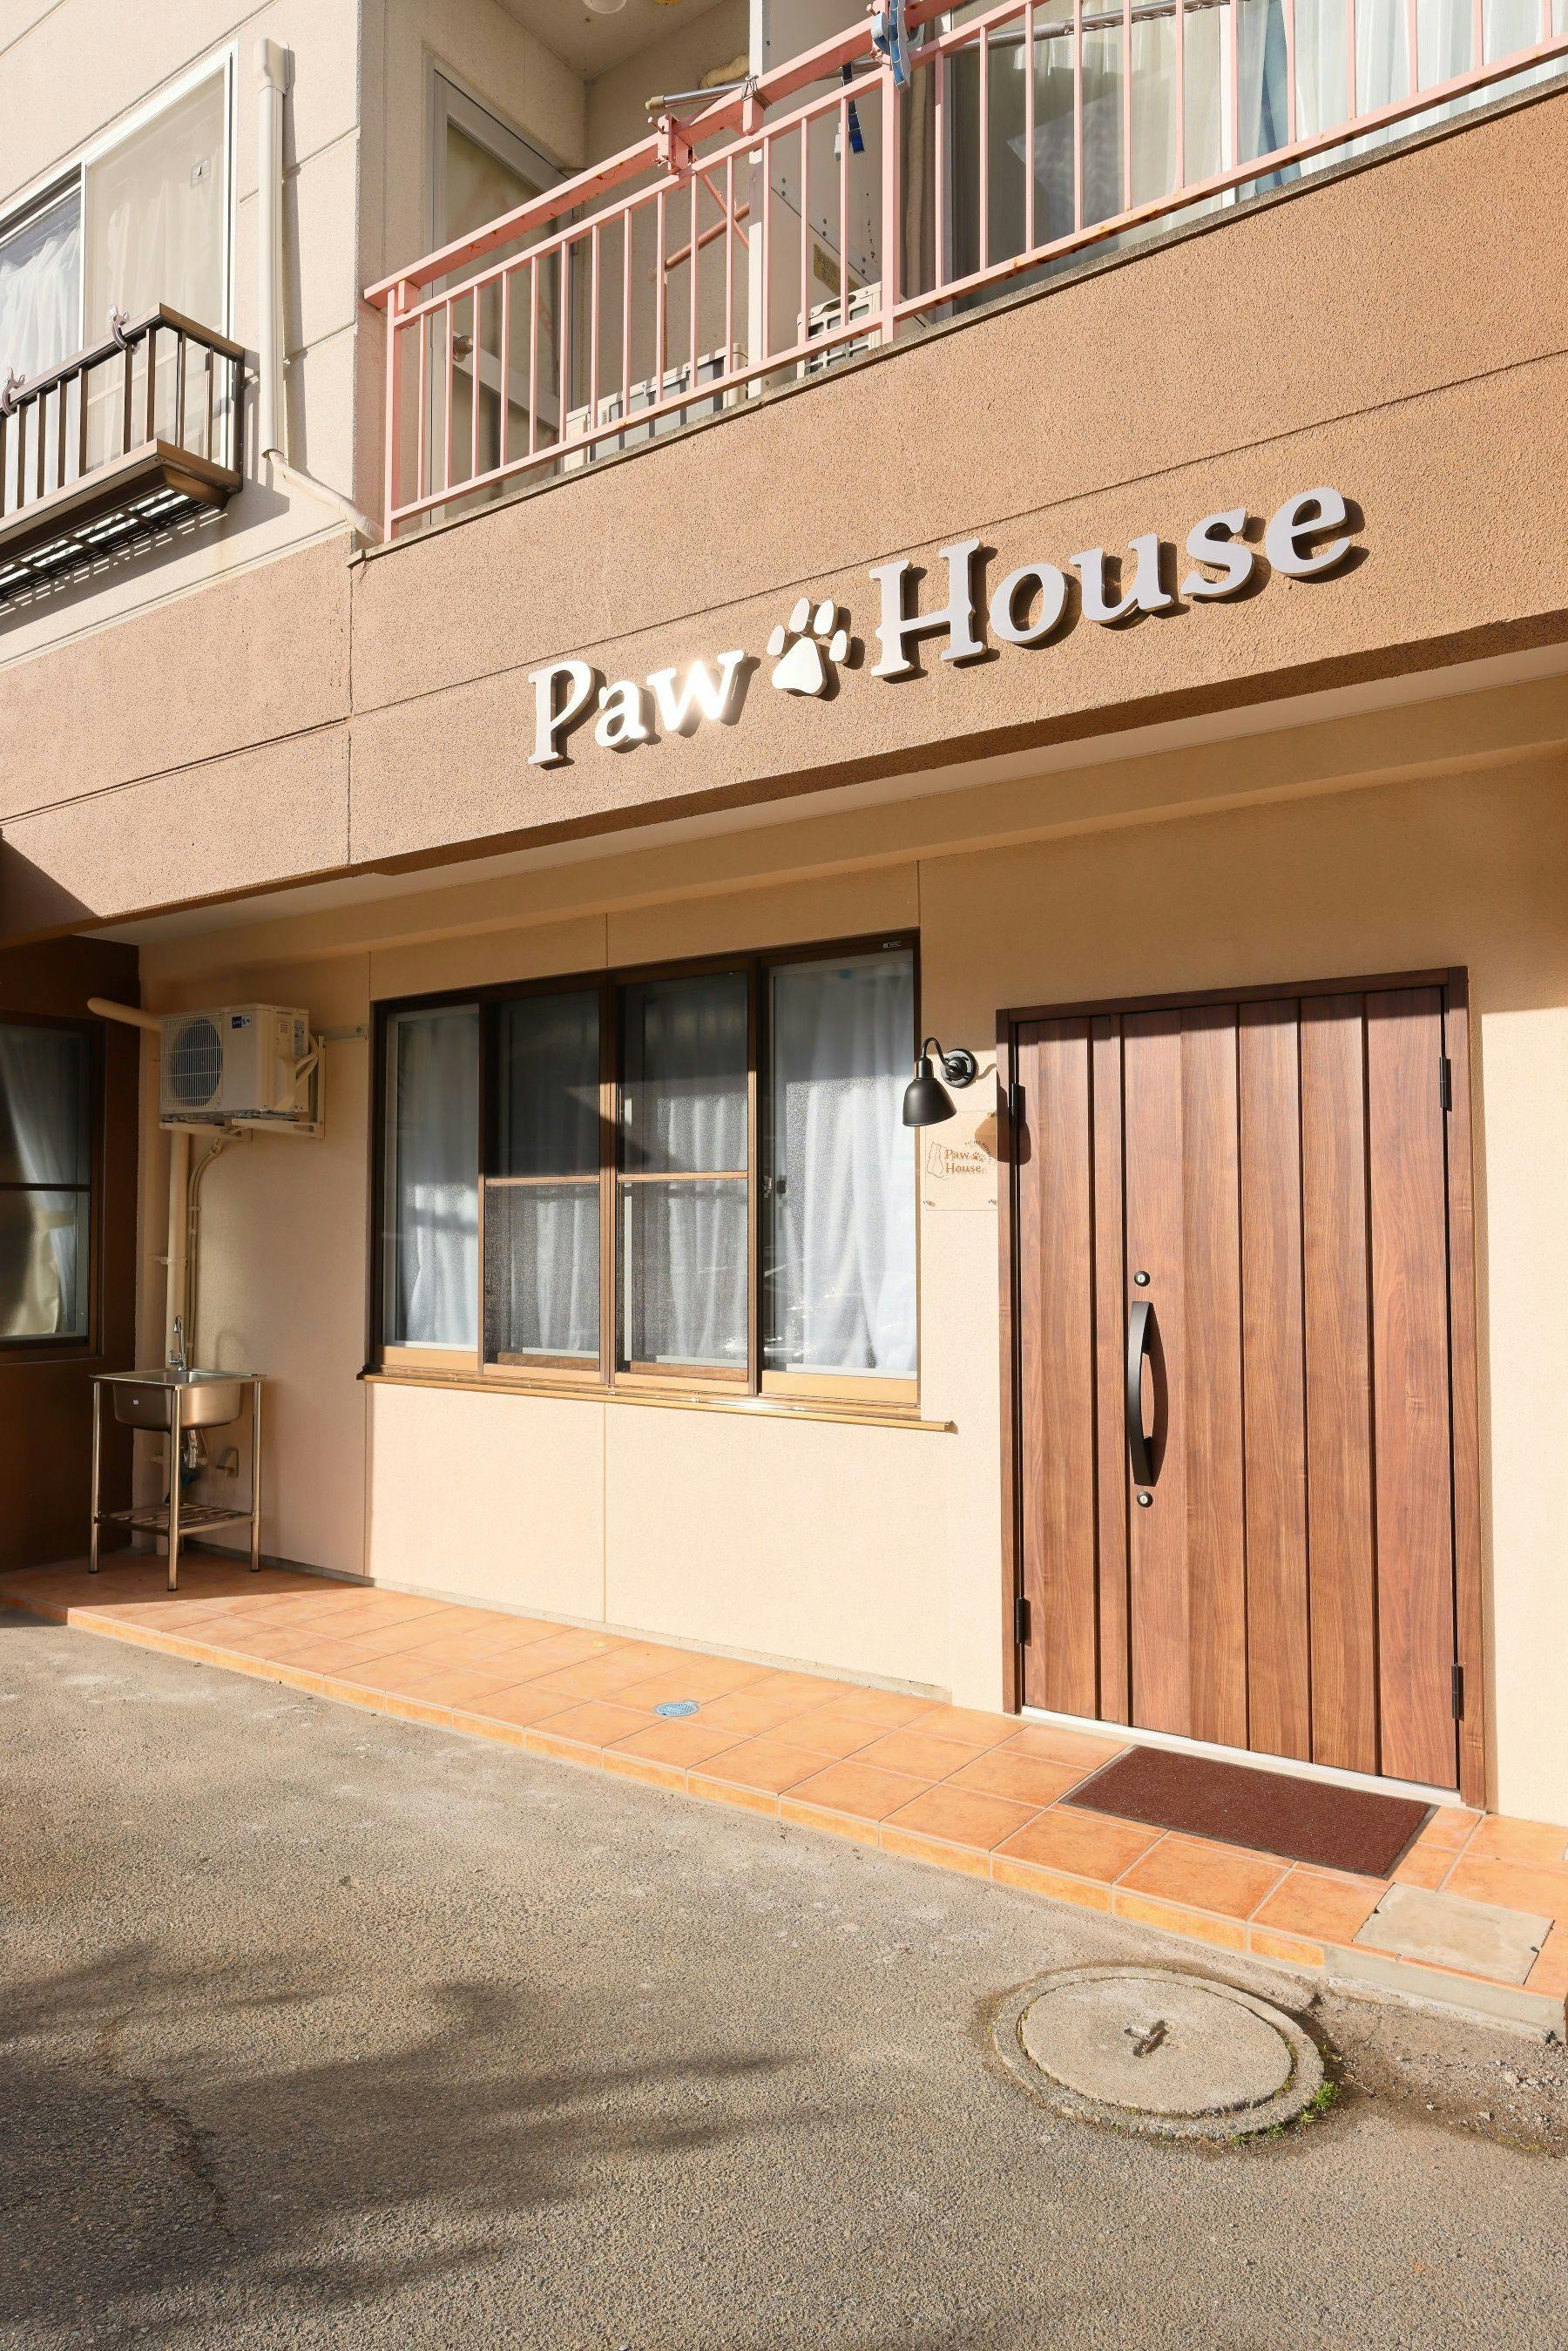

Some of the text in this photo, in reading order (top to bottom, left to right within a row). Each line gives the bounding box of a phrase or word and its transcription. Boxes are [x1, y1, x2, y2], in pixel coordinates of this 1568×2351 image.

[526, 485, 1353, 767] Paw House
[944, 1148, 970, 1159] Paw
[945, 1162, 983, 1174] House
